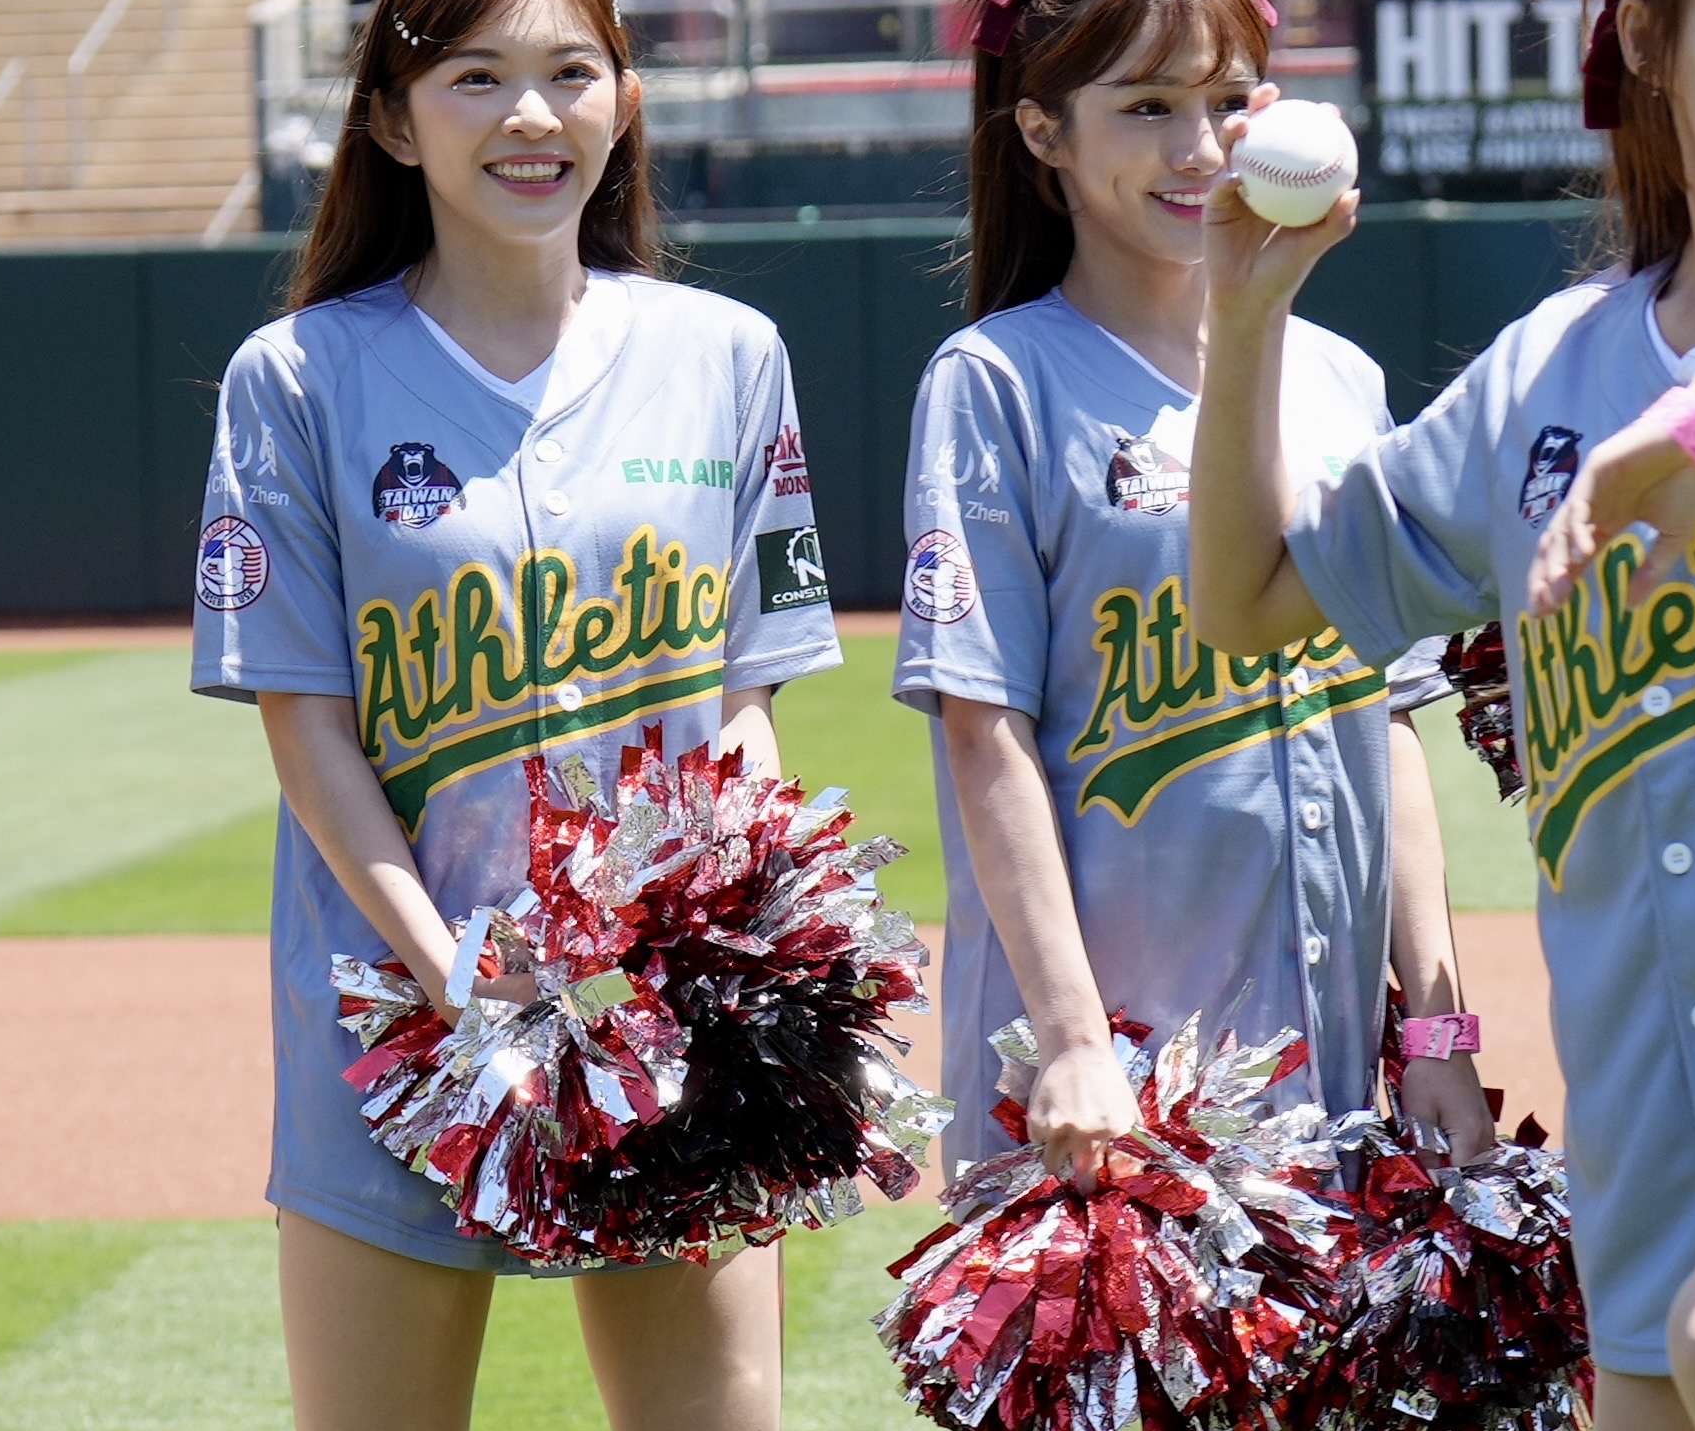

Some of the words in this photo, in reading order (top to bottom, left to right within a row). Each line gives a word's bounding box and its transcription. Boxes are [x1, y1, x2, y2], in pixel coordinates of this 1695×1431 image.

[621, 458, 687, 485] EVA
[691, 458, 734, 491] AIR
[248, 485, 290, 506] Zhen
[383, 488, 452, 507] TAIWAN
[401, 503, 436, 521] DAY
[964, 500, 1009, 525] Zhen
[357, 524, 732, 766] Athletic
